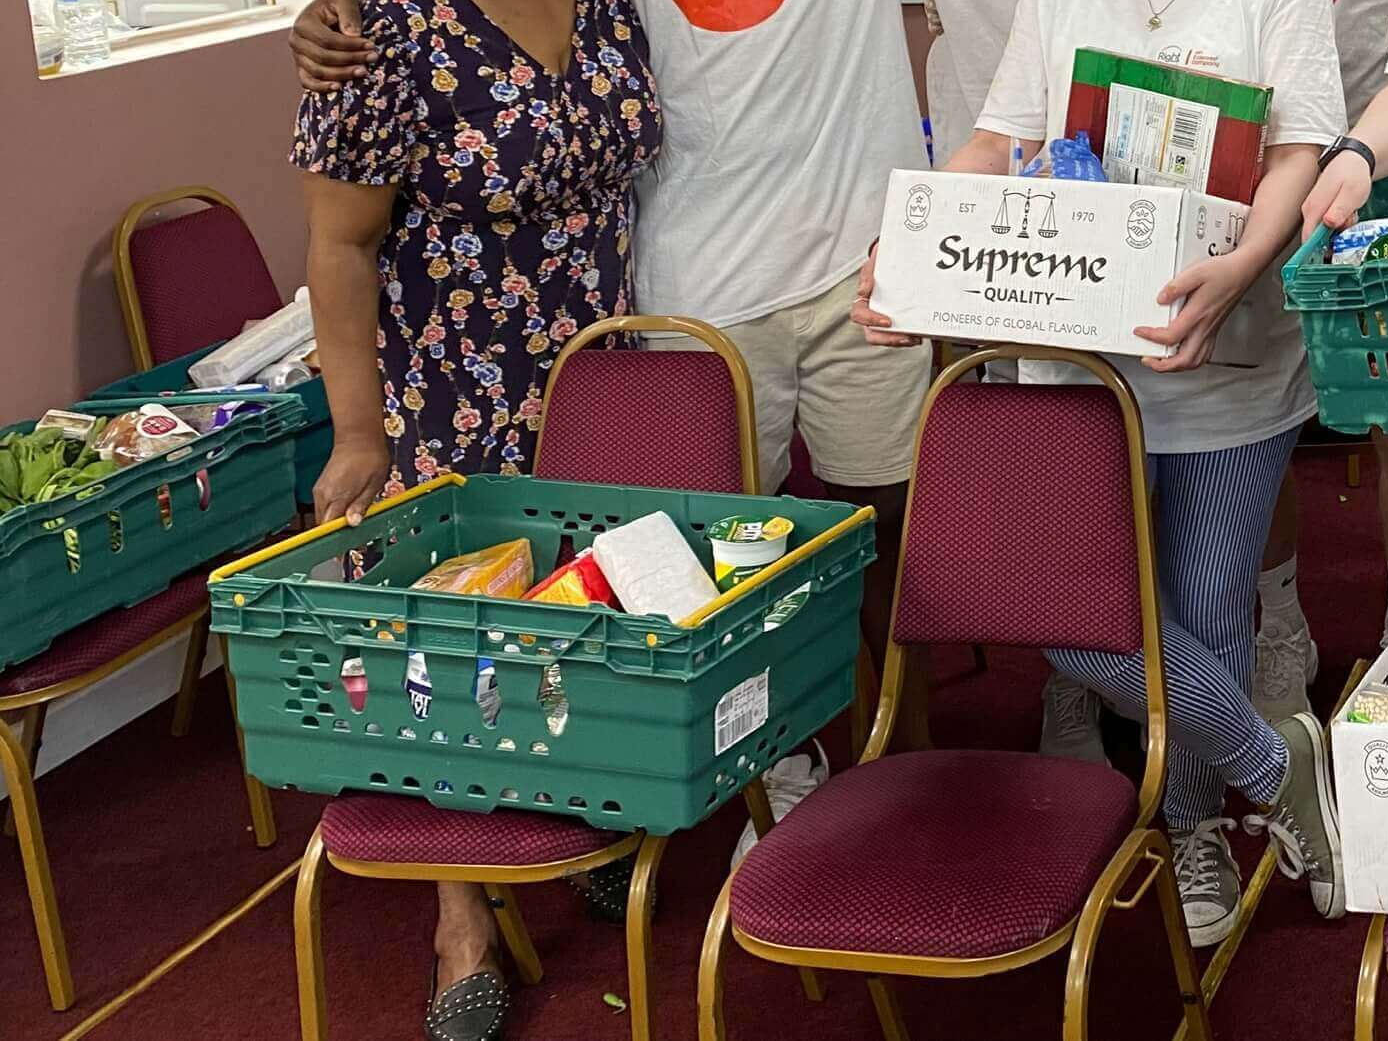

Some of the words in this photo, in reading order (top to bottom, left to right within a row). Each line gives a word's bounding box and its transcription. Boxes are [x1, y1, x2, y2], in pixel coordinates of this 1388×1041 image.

[959, 203, 976, 214] EST
[1071, 211, 1095, 223] 1970
[935, 234, 1107, 283] Supreme
[984, 287, 1055, 306] QUALITY
[932, 311, 982, 326] PIONEERS
[985, 315, 1000, 327] OF
[1003, 317, 1045, 333] GLOBAL
[1048, 321, 1098, 336] FLAVOUR
